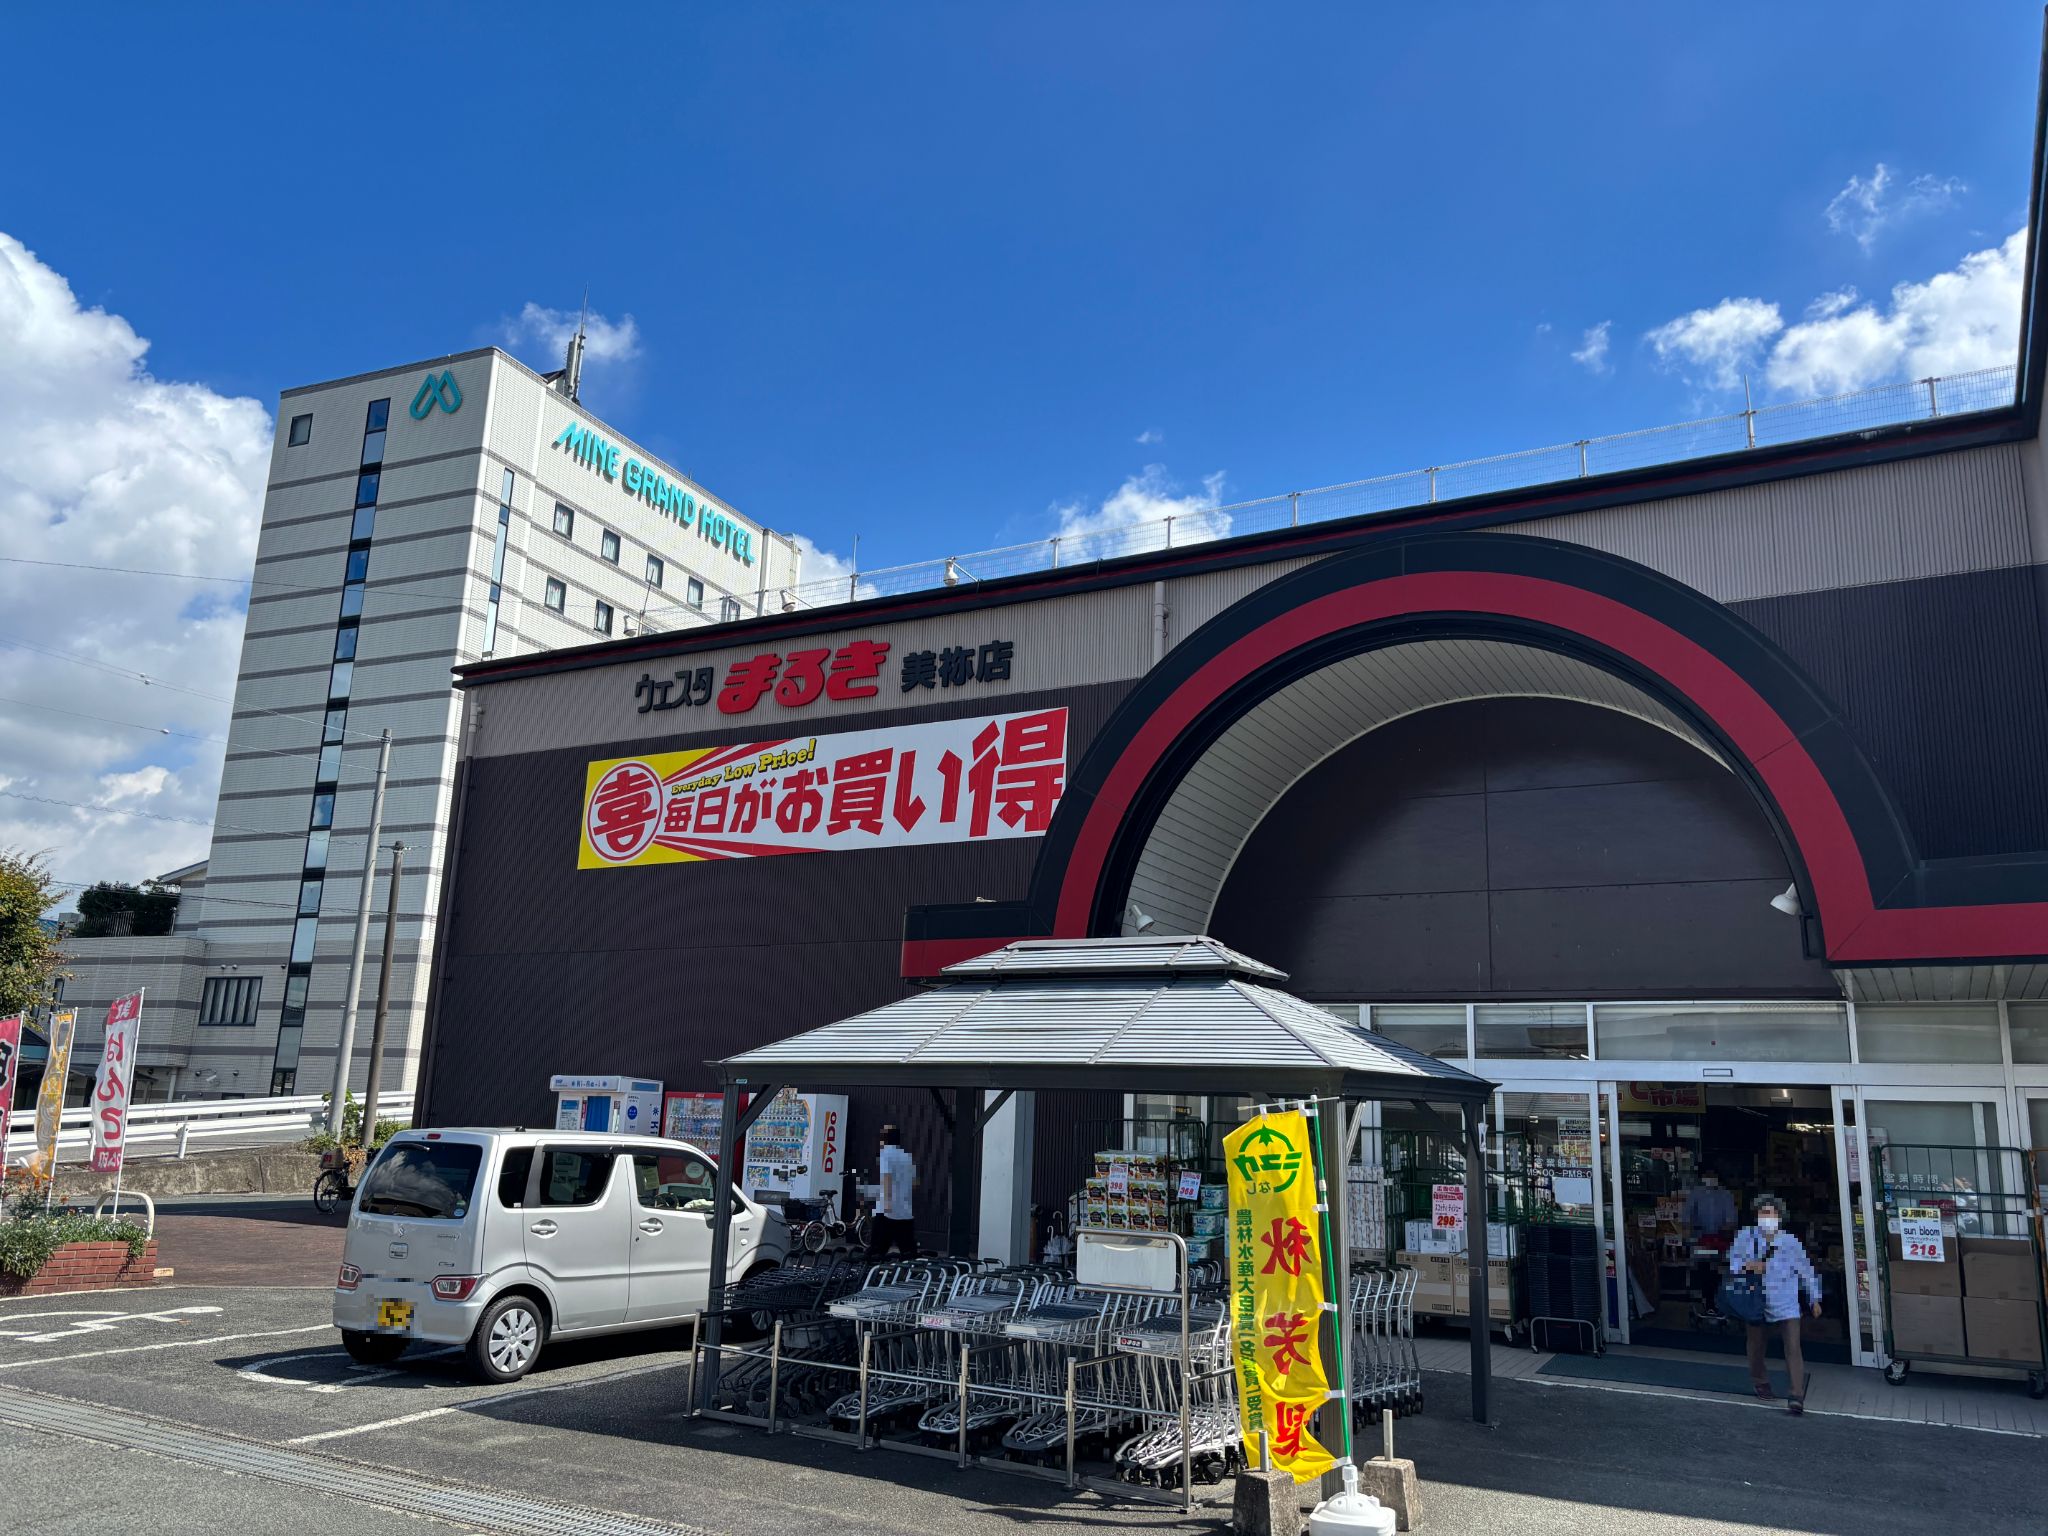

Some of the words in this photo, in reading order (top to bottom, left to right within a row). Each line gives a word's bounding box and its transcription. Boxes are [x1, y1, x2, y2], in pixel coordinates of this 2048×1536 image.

[553, 421, 620, 479] MINE
[623, 457, 697, 525] GRAND
[700, 503, 756, 564] HOTEL
[716, 639, 890, 714] まるき
[900, 640, 1014, 692] 美祢店
[663, 707, 1068, 838] 毎日がお買い得
[671, 773, 723, 795] Everyday
[724, 763, 756, 781] Low
[757, 738, 817, 773] Price!
[1437, 1216, 1455, 1226] 298
[1911, 1244, 1936, 1256] 218
